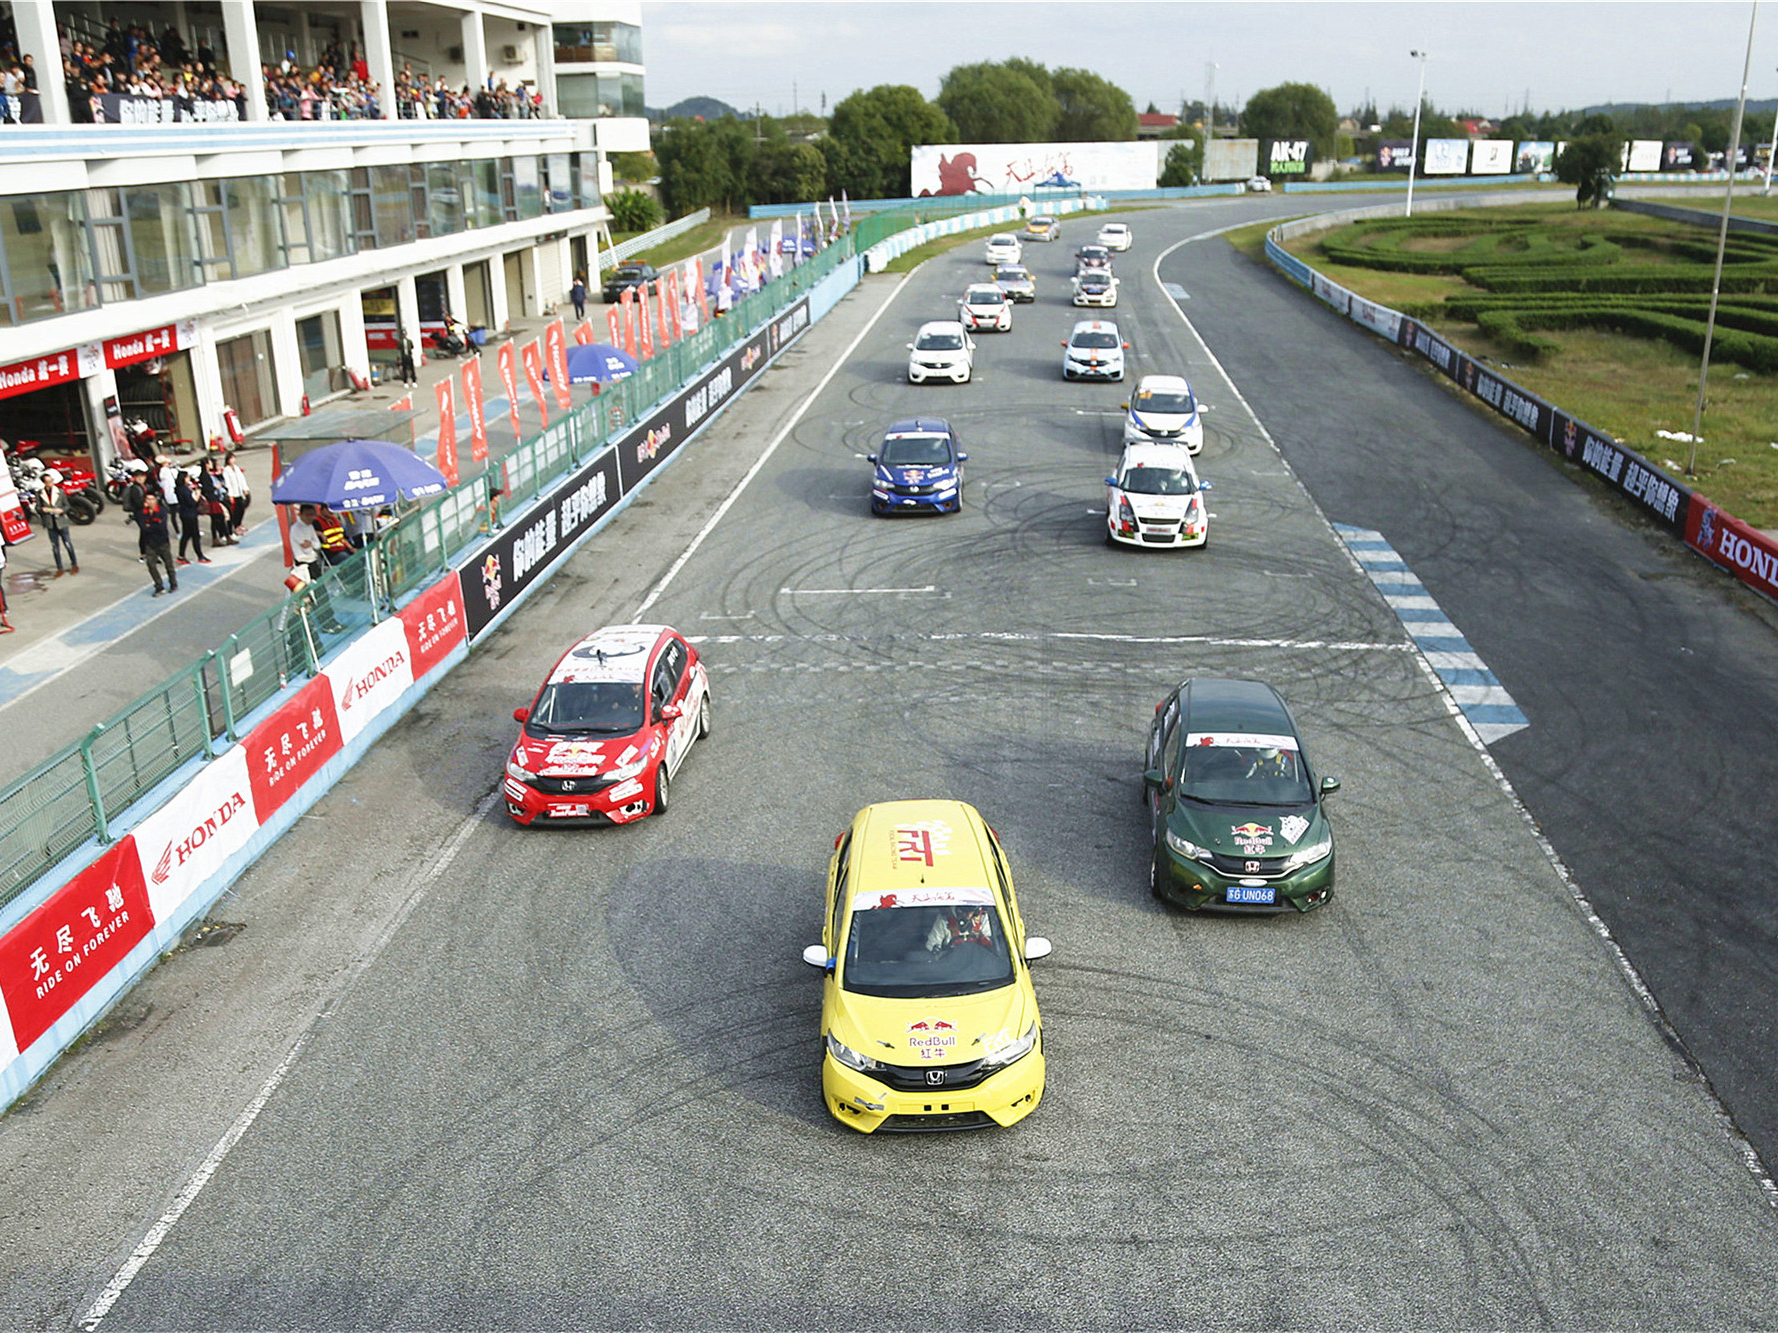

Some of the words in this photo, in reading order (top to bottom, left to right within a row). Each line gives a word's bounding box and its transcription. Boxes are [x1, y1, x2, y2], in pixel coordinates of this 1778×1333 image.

[113, 339, 144, 361] Honda
[1582, 435, 1625, 483] 你的能量
[355, 651, 405, 699] HONDA
[286, 756, 297, 772] ON
[175, 792, 247, 867] HONDA
[30, 882, 125, 981] 无尽飞驰
[35, 970, 63, 999] RIDE
[65, 953, 82, 973] ON
[83, 911, 130, 956] FOREVER
[920, 1048, 947, 1060] 红牛
